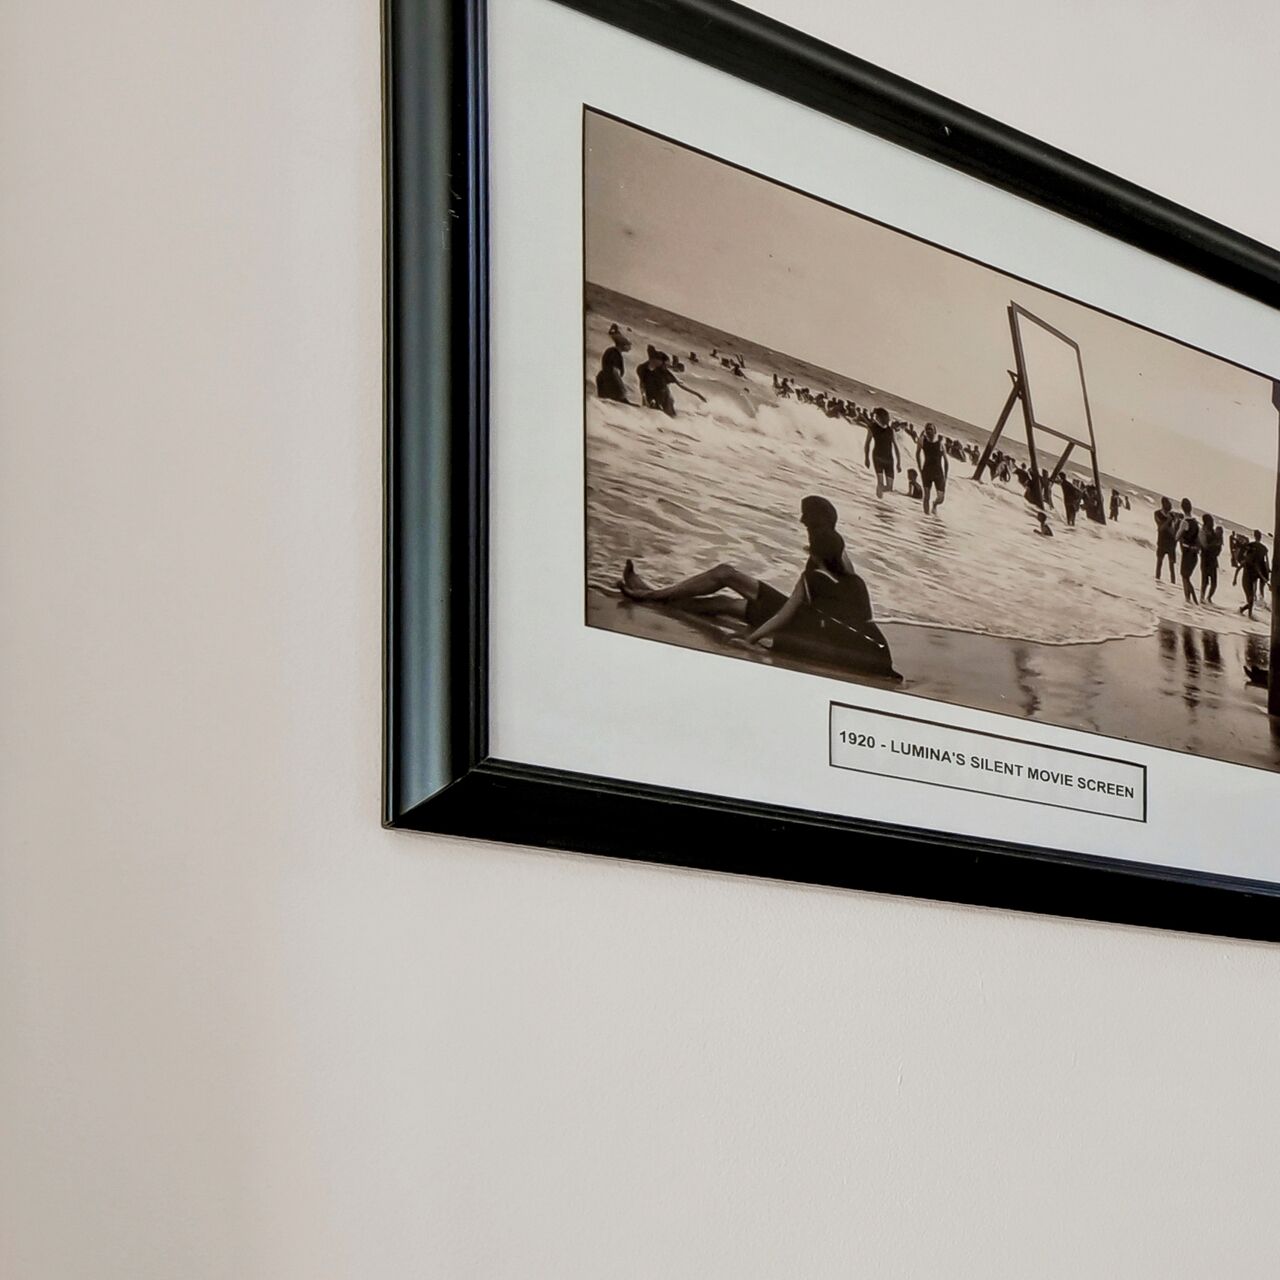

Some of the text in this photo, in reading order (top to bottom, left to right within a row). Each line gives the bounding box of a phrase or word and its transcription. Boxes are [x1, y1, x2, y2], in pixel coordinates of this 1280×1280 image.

[839, 731, 875, 748] 1920
[891, 740, 966, 766] LUMINA'S
[970, 756, 1024, 776] SILENT
[1027, 767, 1073, 787] MOVIE
[1077, 777, 1134, 799] SCREEN
